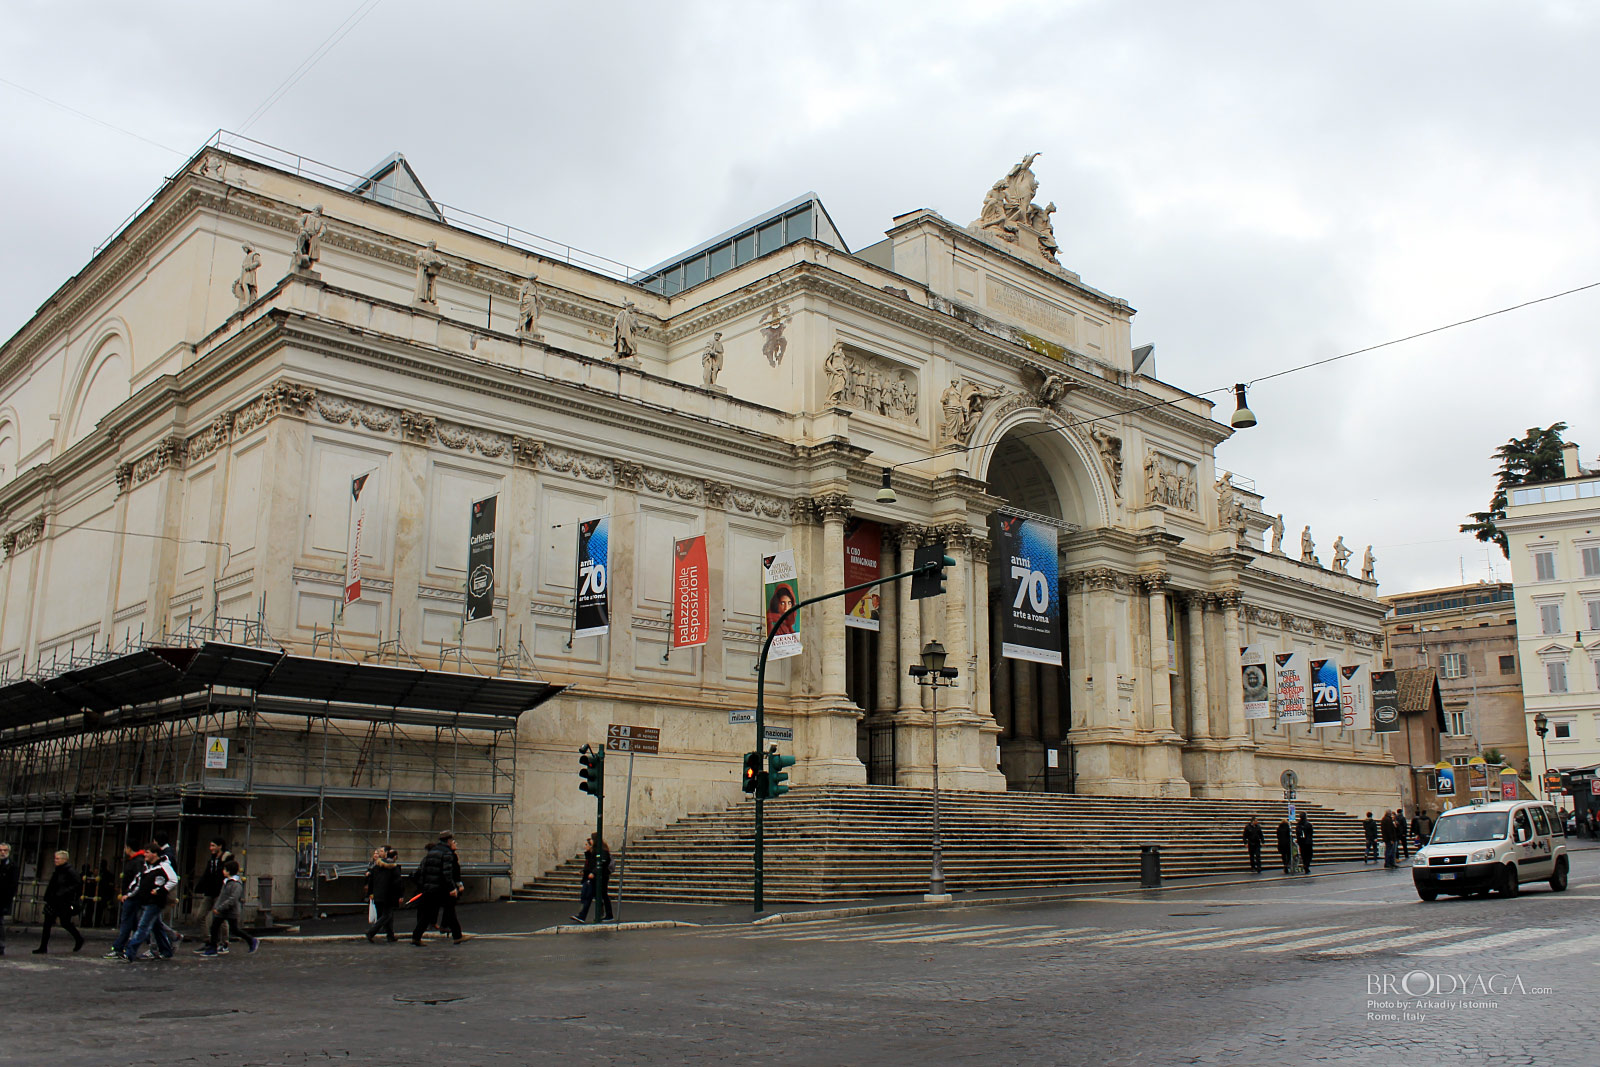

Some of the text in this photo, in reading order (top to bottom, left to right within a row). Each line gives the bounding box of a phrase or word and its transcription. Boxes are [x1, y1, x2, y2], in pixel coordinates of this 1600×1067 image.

[850, 546, 861, 556] CIBO
[581, 558, 594, 567] anni
[1011, 555, 1030, 568] anni
[580, 564, 606, 595] 70
[1011, 565, 1049, 614] 70
[689, 566, 701, 642] esposizioni
[1012, 610, 1026, 619] arte
[1032, 614, 1050, 624] roma
[1277, 669, 1296, 677] MOSTRE
[1313, 686, 1337, 704] 70
[1342, 685, 1357, 727] open
[731, 714, 751, 722] milano
[765, 730, 792, 738] nazionale
[1438, 778, 1451, 788] 70
